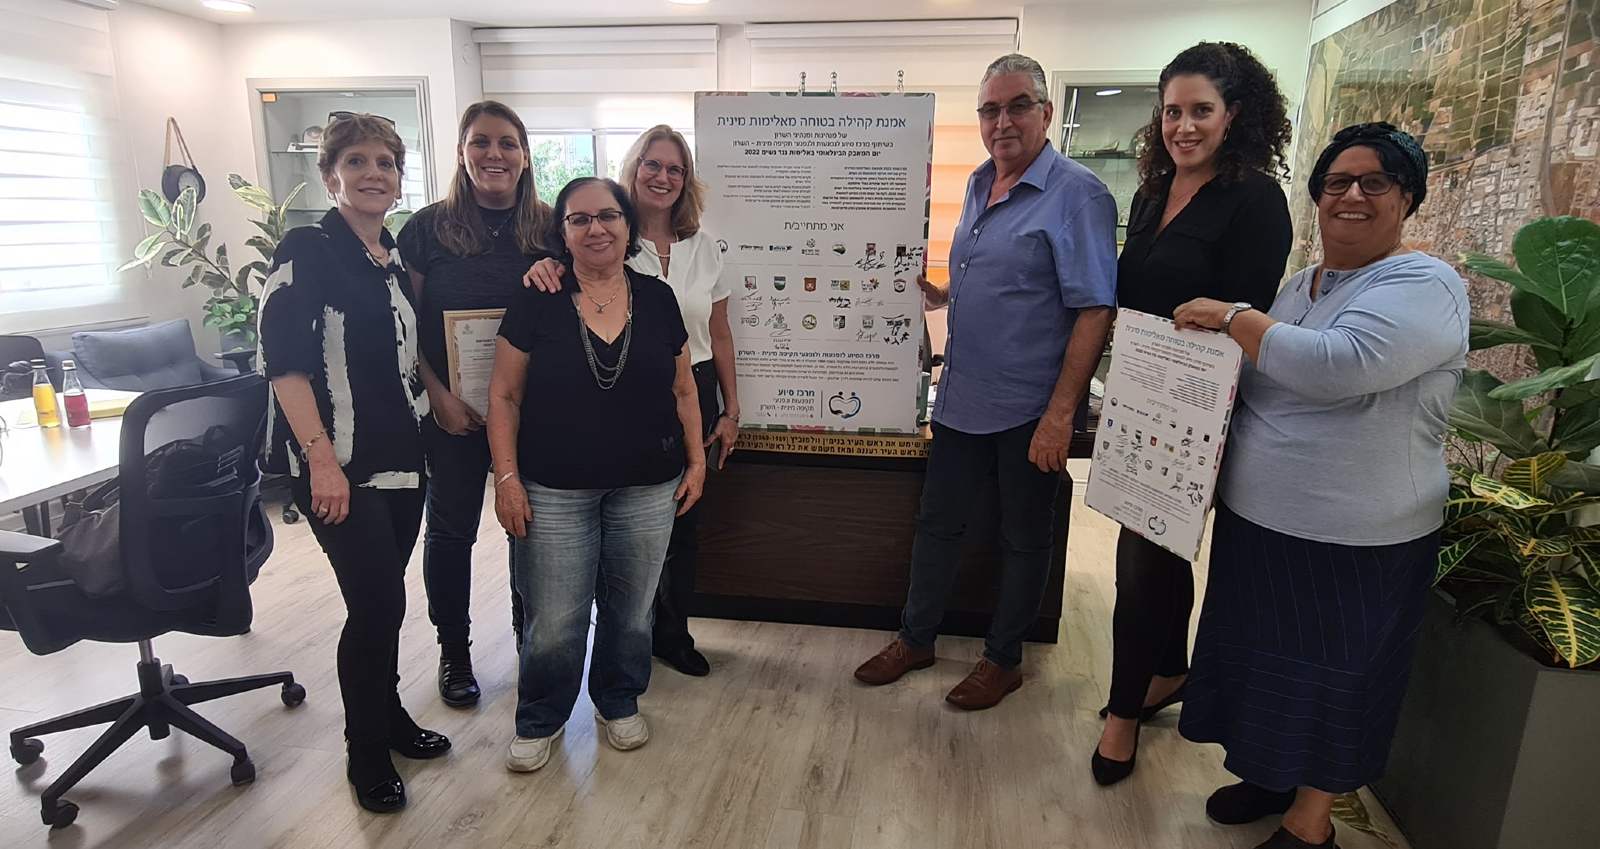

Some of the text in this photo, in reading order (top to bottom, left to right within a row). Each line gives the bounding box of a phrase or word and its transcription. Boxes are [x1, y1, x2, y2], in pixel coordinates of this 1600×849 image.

[717, 114, 906, 131] אמנת קהילה בטוחה מאלימות מינית
[774, 131, 791, 139] השרון
[837, 131, 848, 139] של
[789, 149, 814, 157] באלימות
[816, 149, 847, 157] הבינלאומי
[847, 149, 871, 158] המאבק
[830, 222, 845, 231] אני
[778, 389, 815, 397] מרכז סיוע
[846, 438, 865, 446] העיר
[866, 439, 883, 447] ראש
[898, 440, 921, 448] שימש
[787, 443, 796, 451] כל
[797, 444, 809, 452] את
[811, 445, 835, 453] משמש
[837, 446, 854, 454] ומאז
[856, 447, 878, 455] רעננה
[879, 448, 898, 456] העיר
